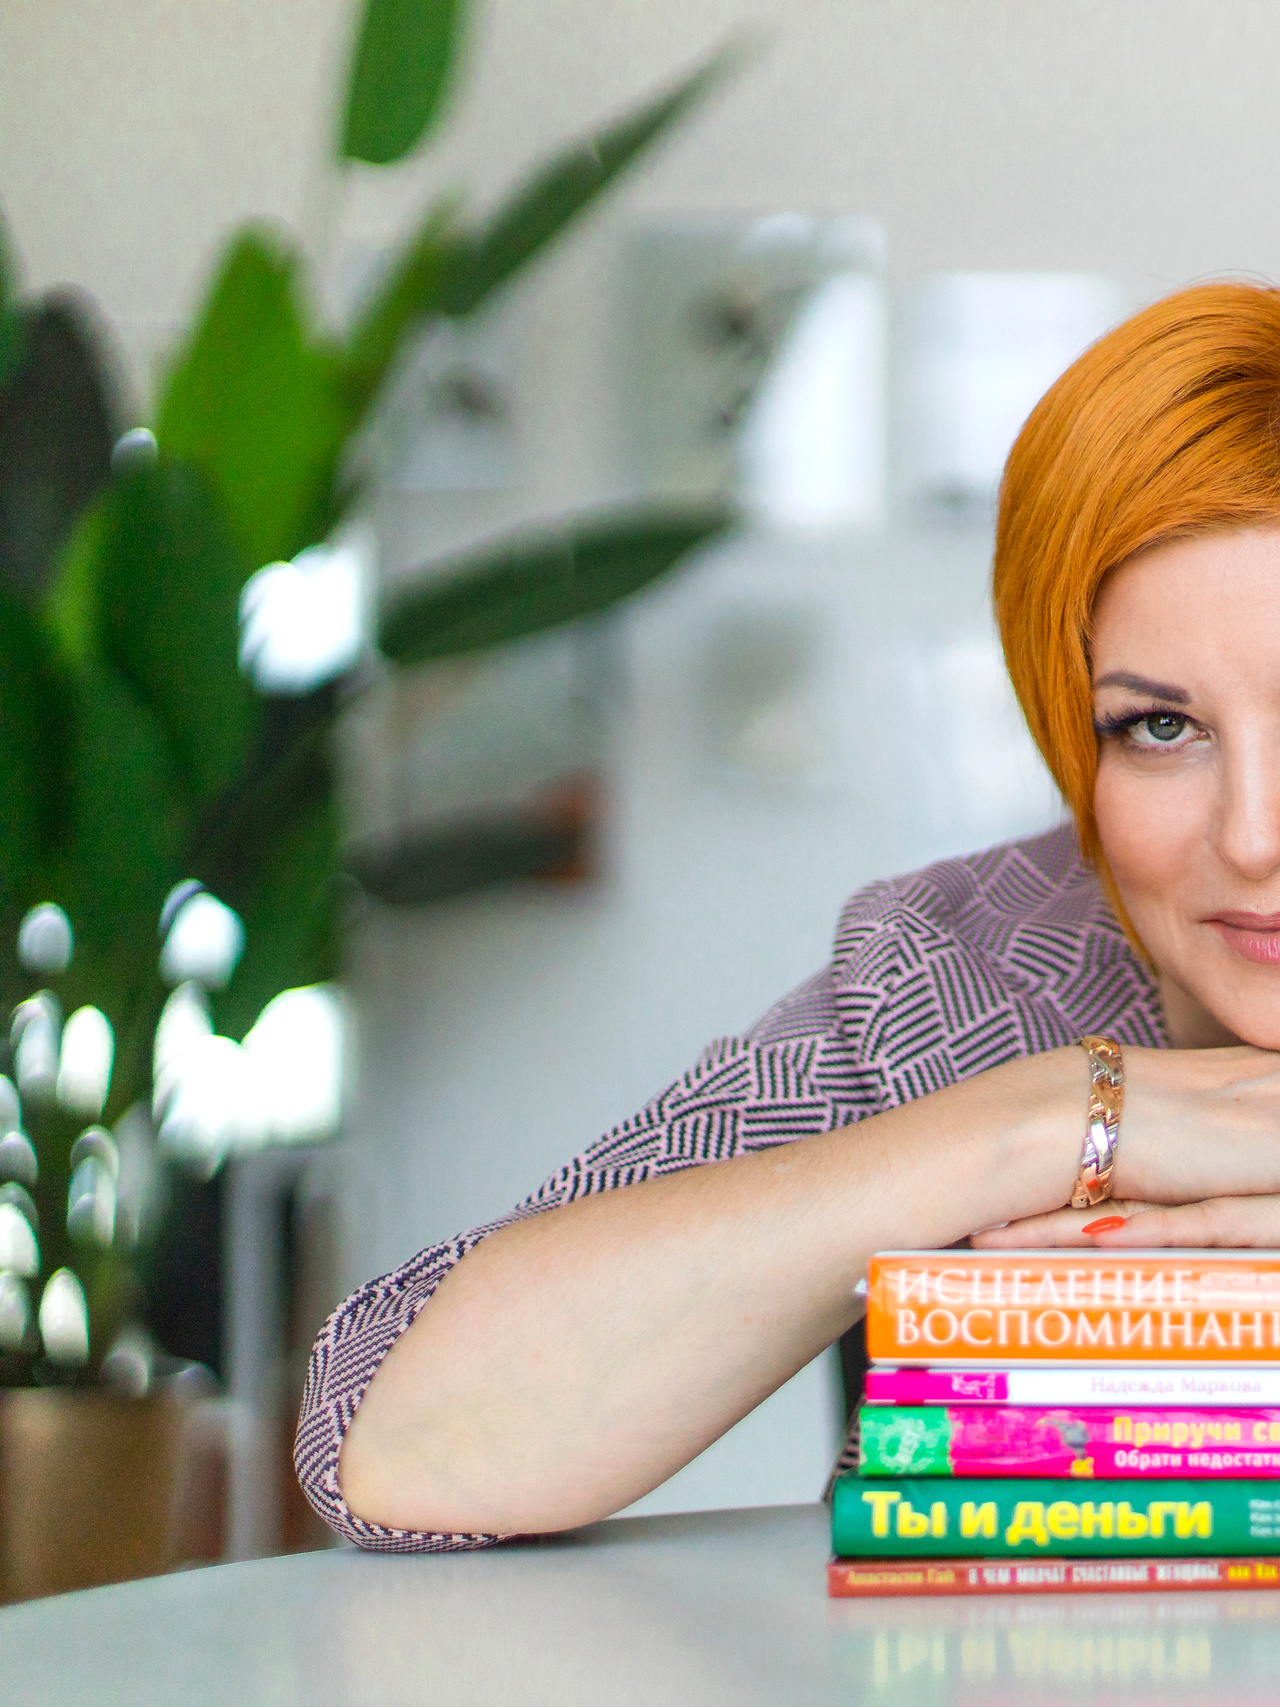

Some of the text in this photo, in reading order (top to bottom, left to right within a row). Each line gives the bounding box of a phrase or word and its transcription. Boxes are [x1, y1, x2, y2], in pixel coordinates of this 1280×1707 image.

[896, 1268, 1194, 1306] ИСЦЕЛЕНИЕ
[1091, 1377, 1262, 1396] Надежда Маркова
[1113, 1416, 1242, 1448] Приручи
[1114, 1449, 1183, 1470] Обрати
[862, 1490, 1213, 1546] Ты и деньги
